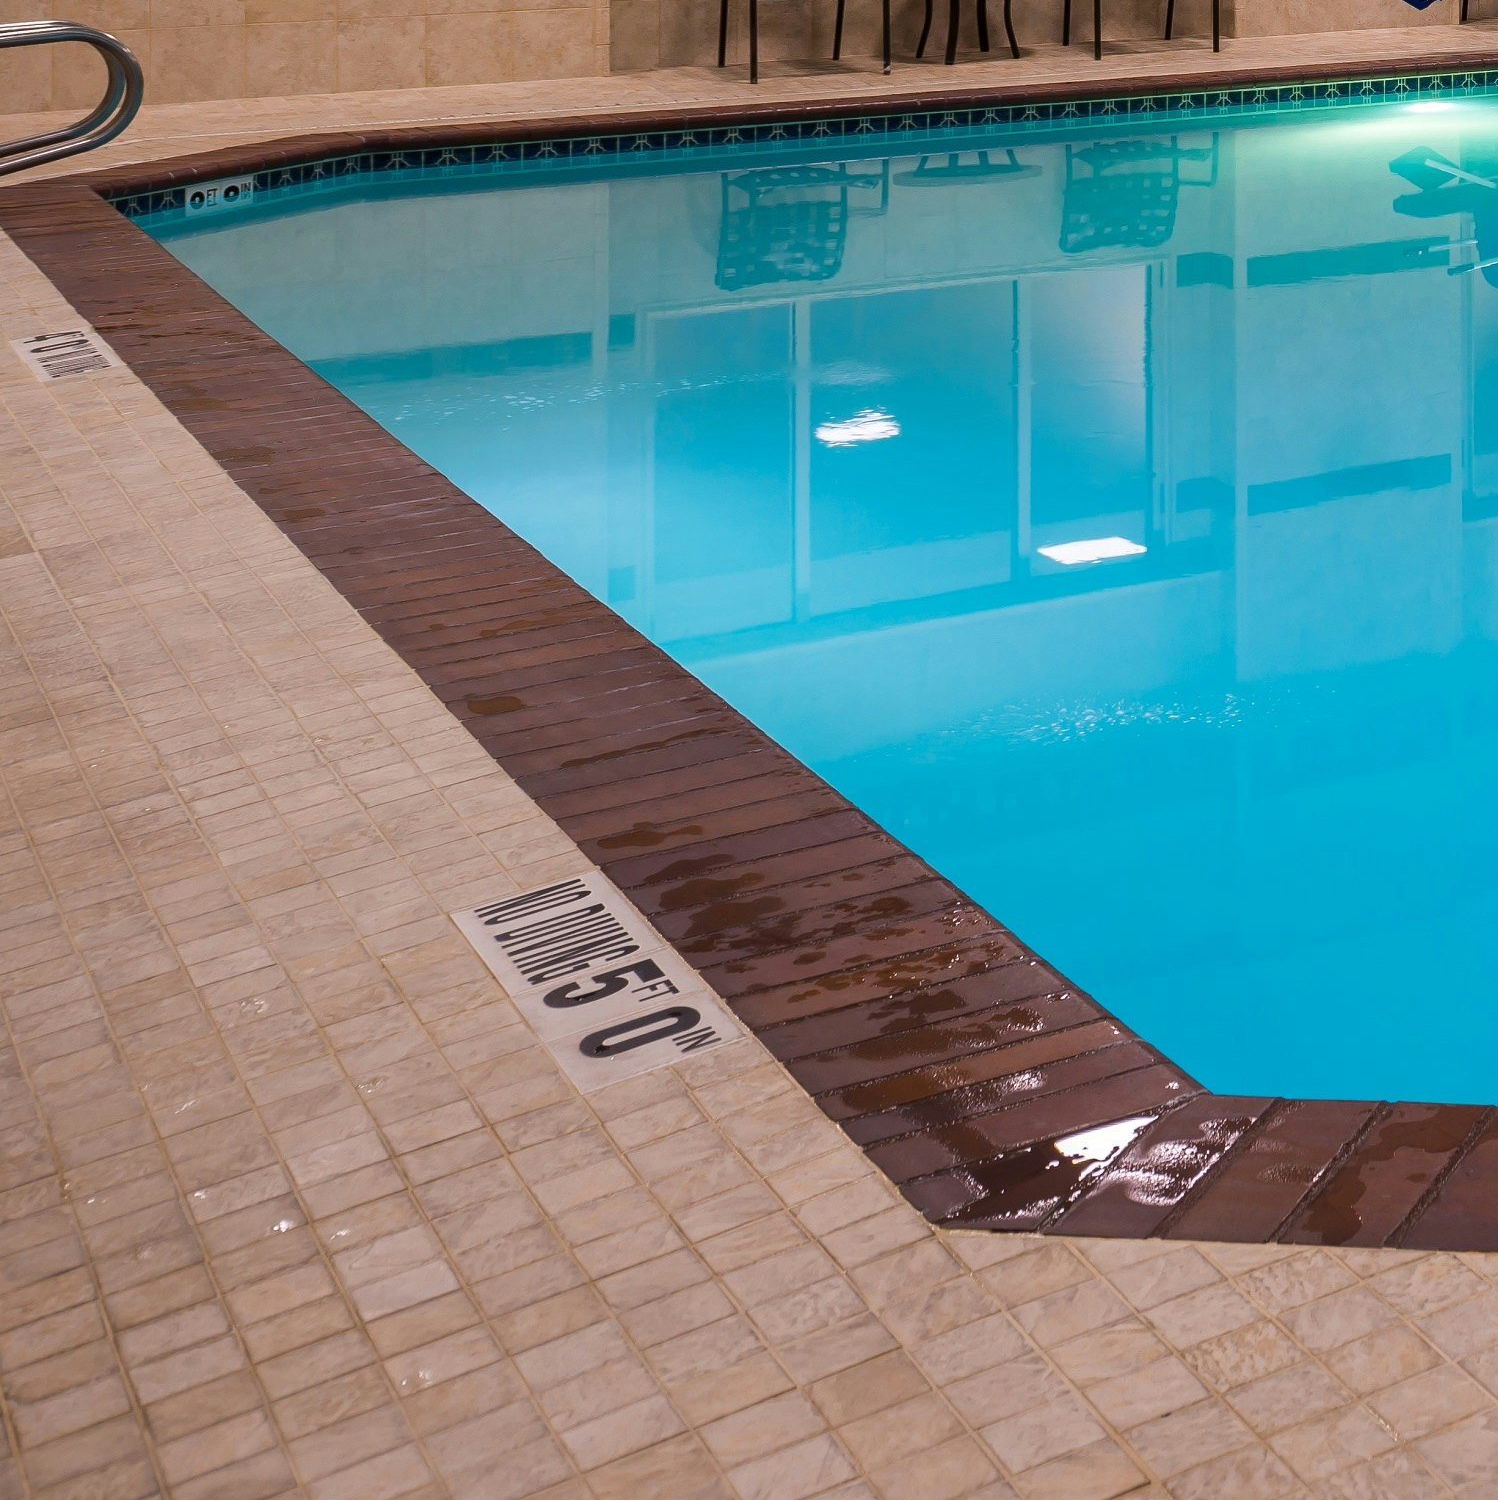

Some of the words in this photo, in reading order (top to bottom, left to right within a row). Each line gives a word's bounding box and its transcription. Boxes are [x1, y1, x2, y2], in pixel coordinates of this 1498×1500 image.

[474, 878, 592, 926] NO
[494, 903, 640, 985] DIVING
[543, 958, 665, 1009] 5
[631, 979, 680, 1002] FT
[579, 1006, 701, 1058] 0
[671, 1026, 722, 1053] IN
